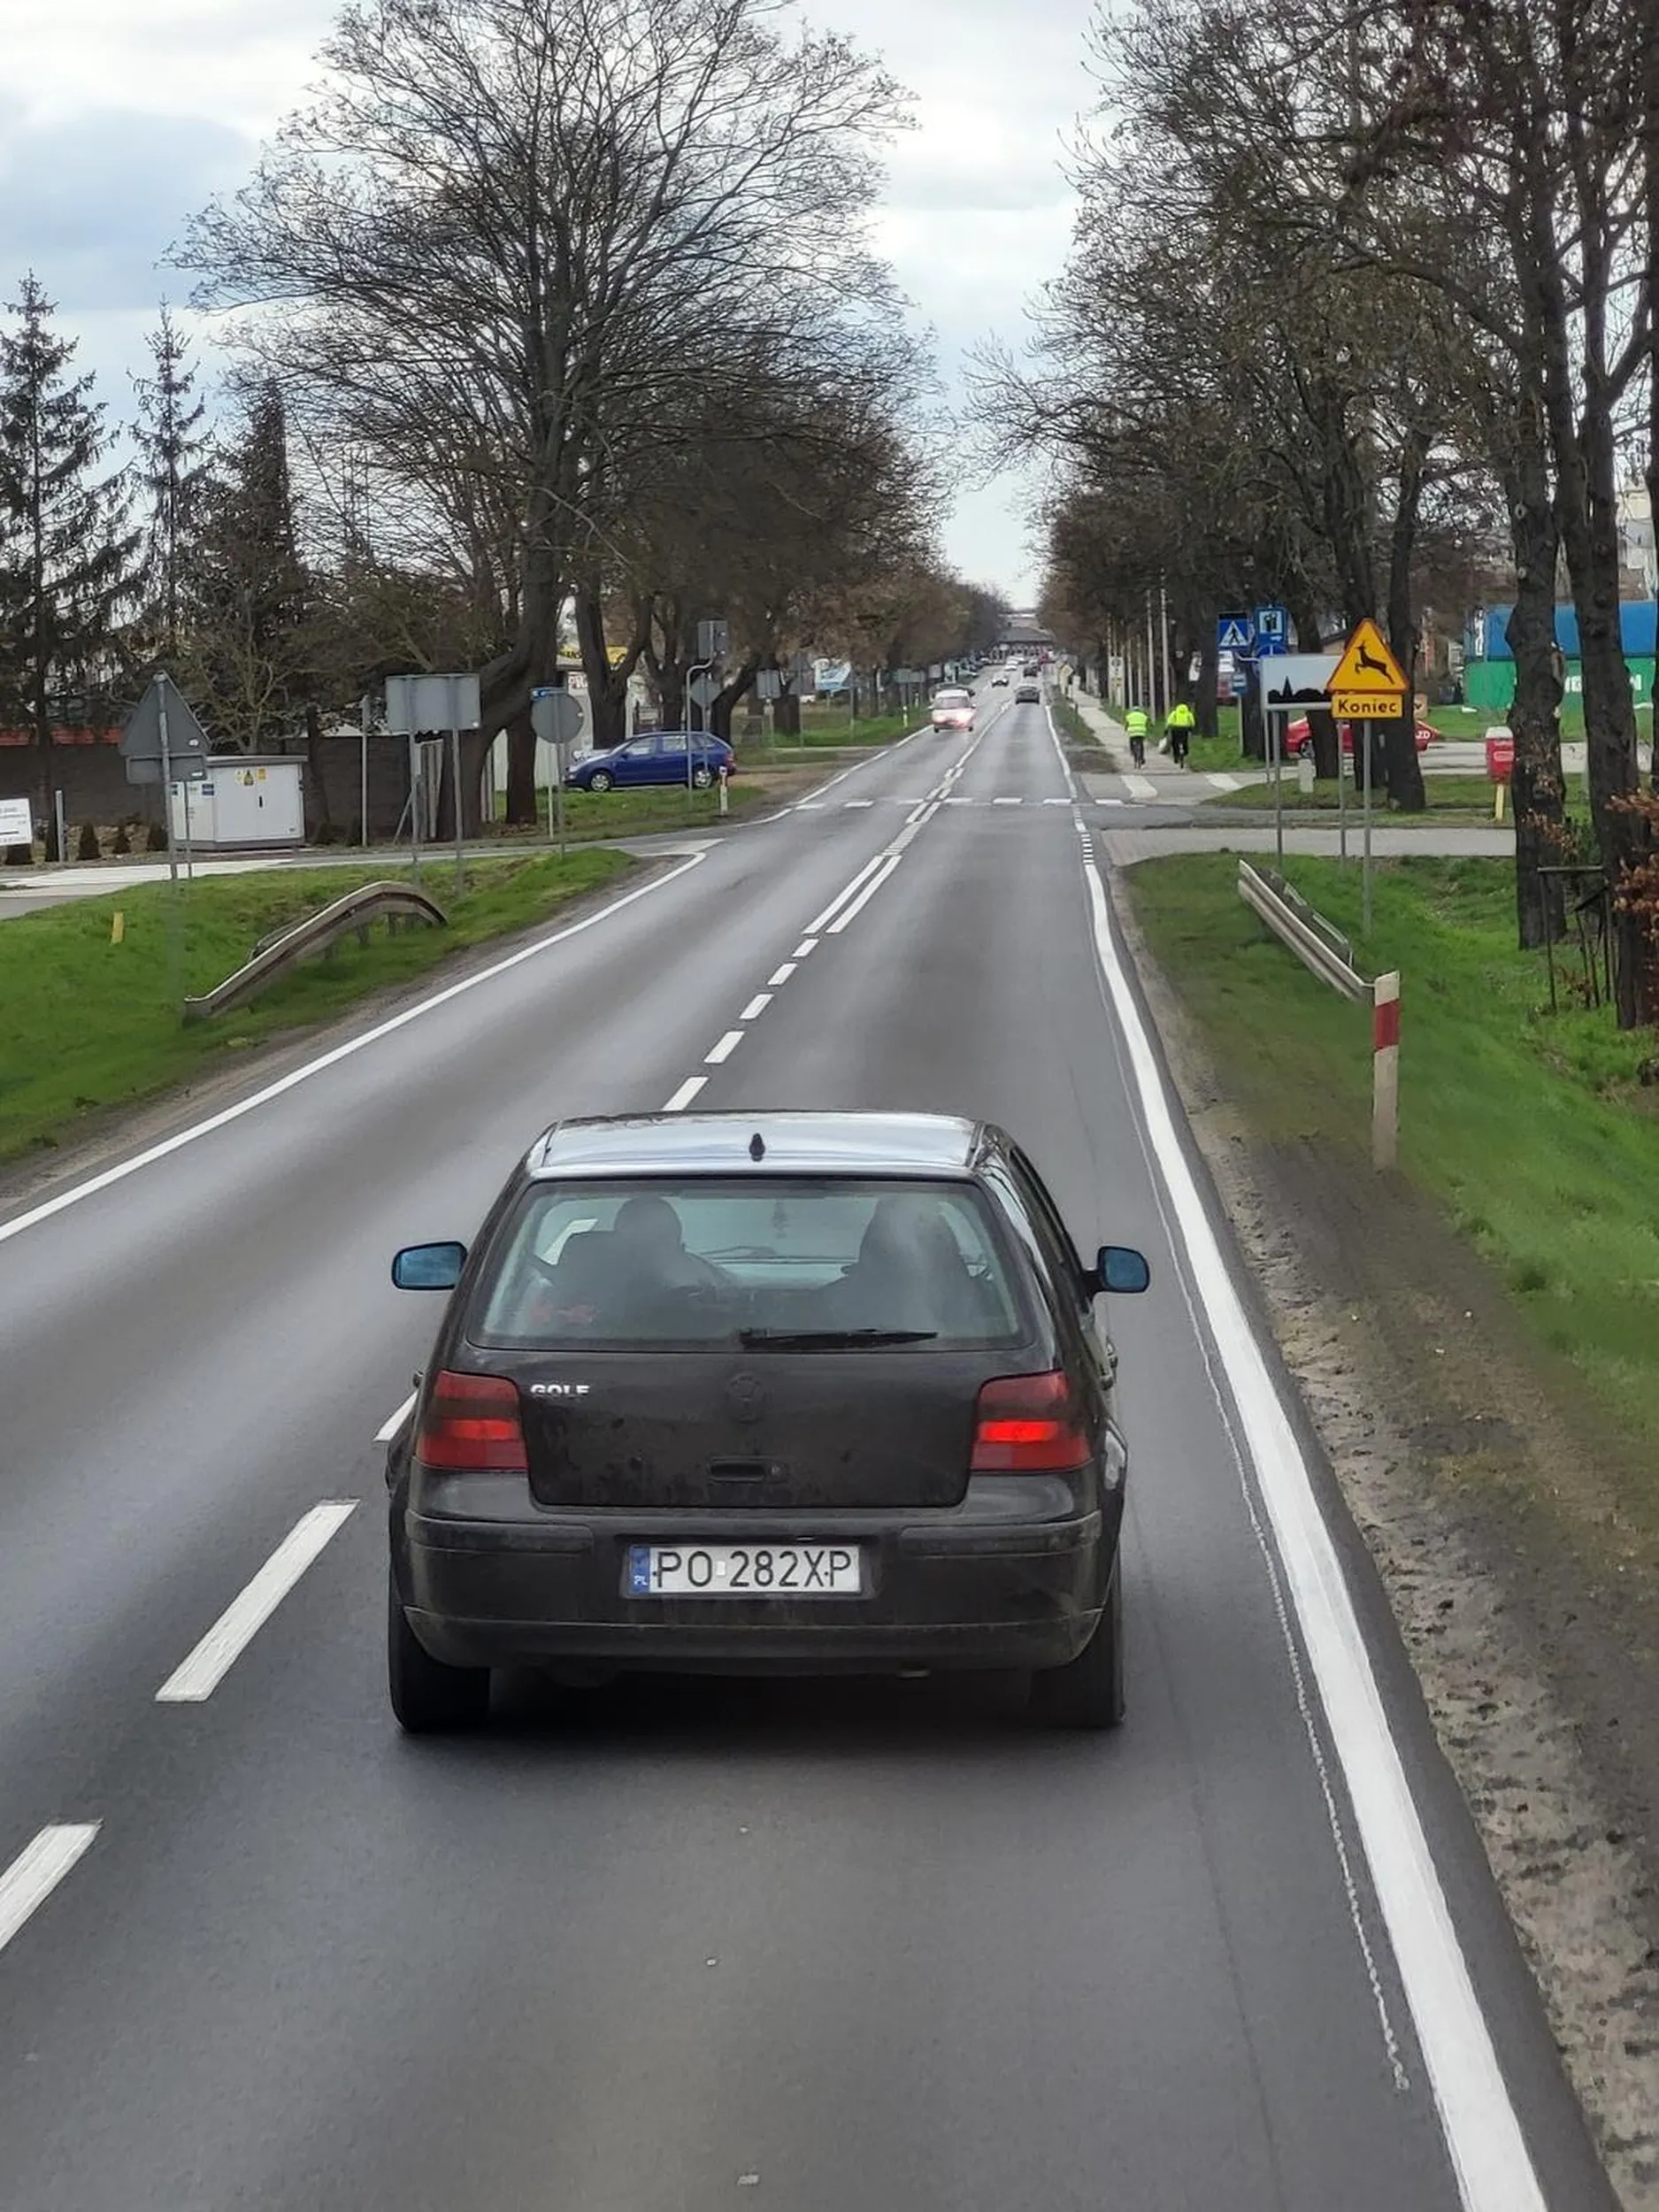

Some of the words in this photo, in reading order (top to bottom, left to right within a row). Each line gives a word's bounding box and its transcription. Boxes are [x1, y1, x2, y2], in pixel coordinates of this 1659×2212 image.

[1338, 698, 1397, 713] Koniec
[657, 1550, 713, 1588] PO
[729, 1550, 851, 1588] 282XP
[634, 1574, 648, 1586] PL
